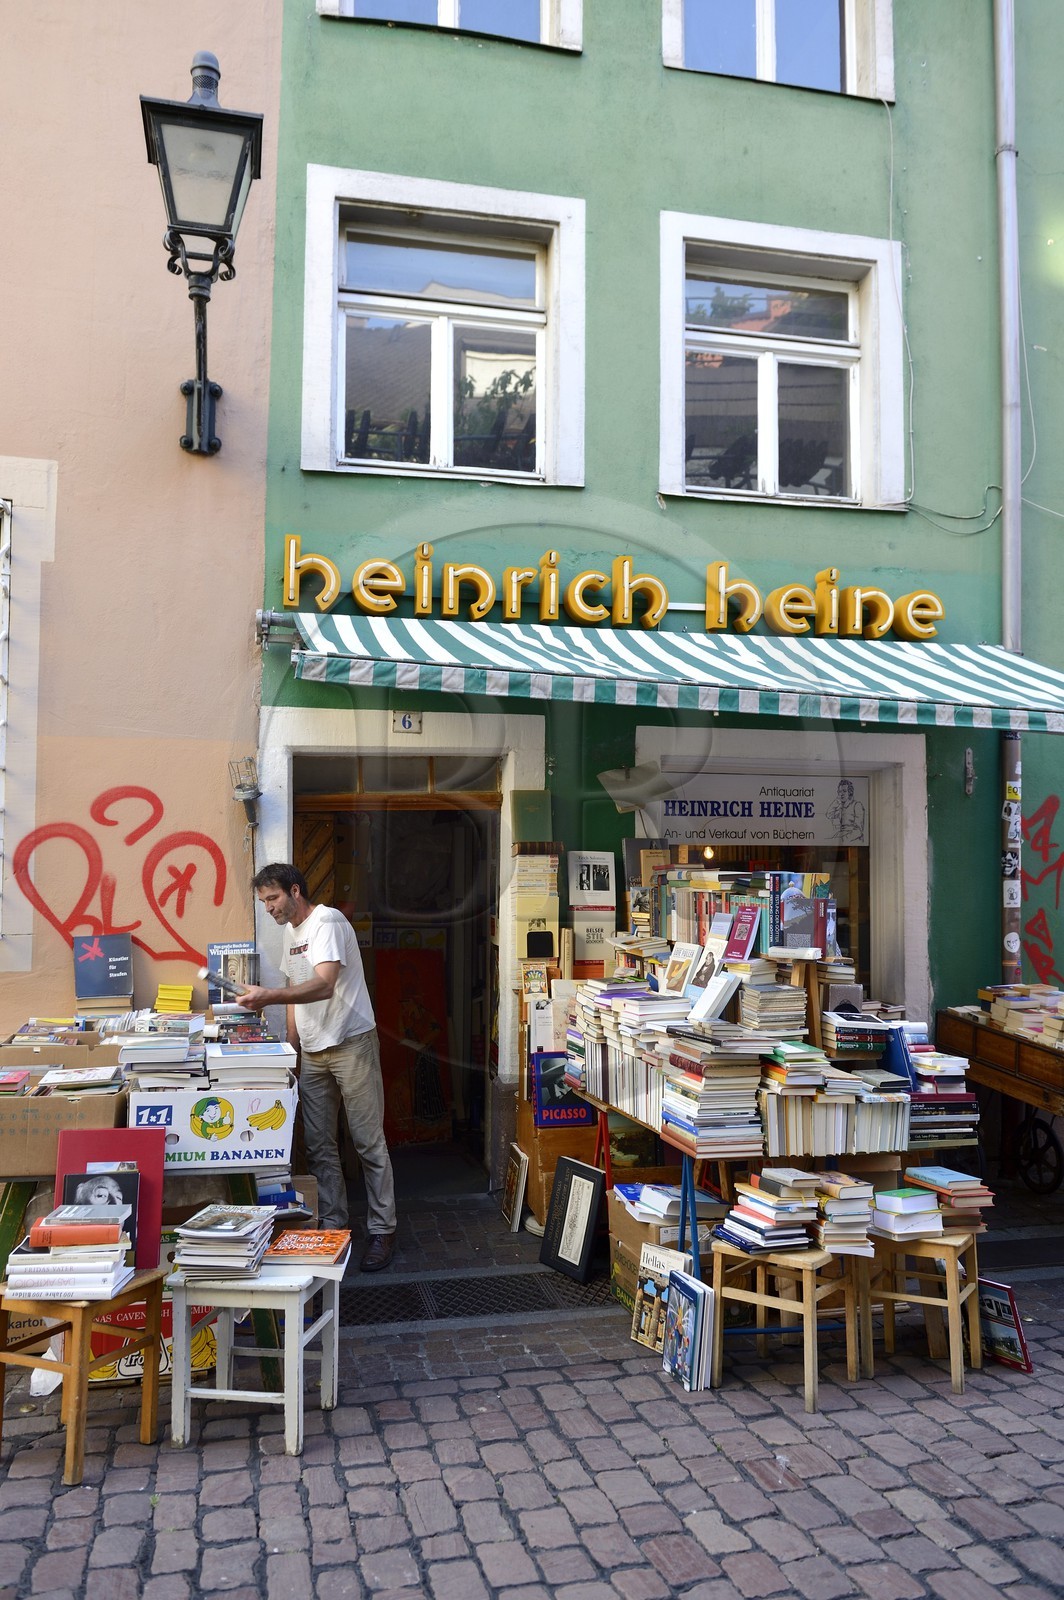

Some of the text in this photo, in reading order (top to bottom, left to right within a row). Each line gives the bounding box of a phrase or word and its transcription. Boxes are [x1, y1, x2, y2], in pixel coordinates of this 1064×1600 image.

[283, 533, 946, 639] heinrich heine
[402, 713, 412, 729] 6
[759, 786, 815, 798] Antiquariat
[664, 800, 815, 818] HEINRICH HEINE
[664, 828, 815, 840] An- und Verkauf von Büchern
[542, 1107, 587, 1120] PICASSO
[210, 1149, 285, 1161] BANANEN
[642, 1251, 666, 1271] Hellas
